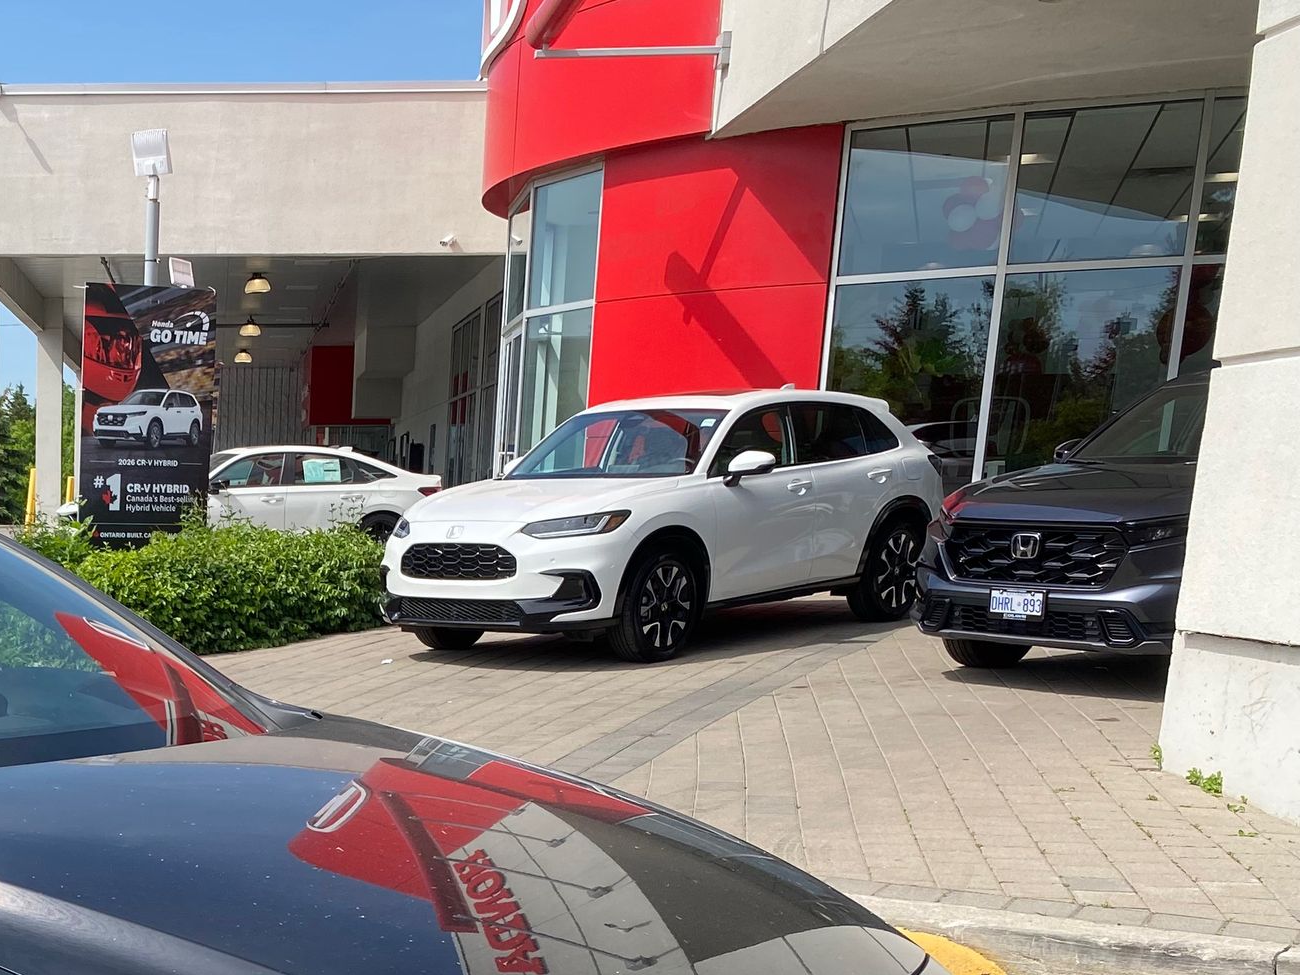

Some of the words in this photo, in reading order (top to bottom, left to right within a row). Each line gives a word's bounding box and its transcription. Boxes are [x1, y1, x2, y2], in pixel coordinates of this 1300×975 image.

[152, 320, 174, 328] Honda
[150, 329, 172, 343] GO
[174, 330, 208, 345] TIME
[126, 483, 151, 493] CR-V
[152, 484, 190, 493] HYBRID
[126, 494, 158, 502] Canada's
[126, 504, 150, 513] Hybrid
[151, 504, 176, 512] Vehicle
[991, 596, 1015, 611] DHRL
[1023, 598, 1042, 613] 893
